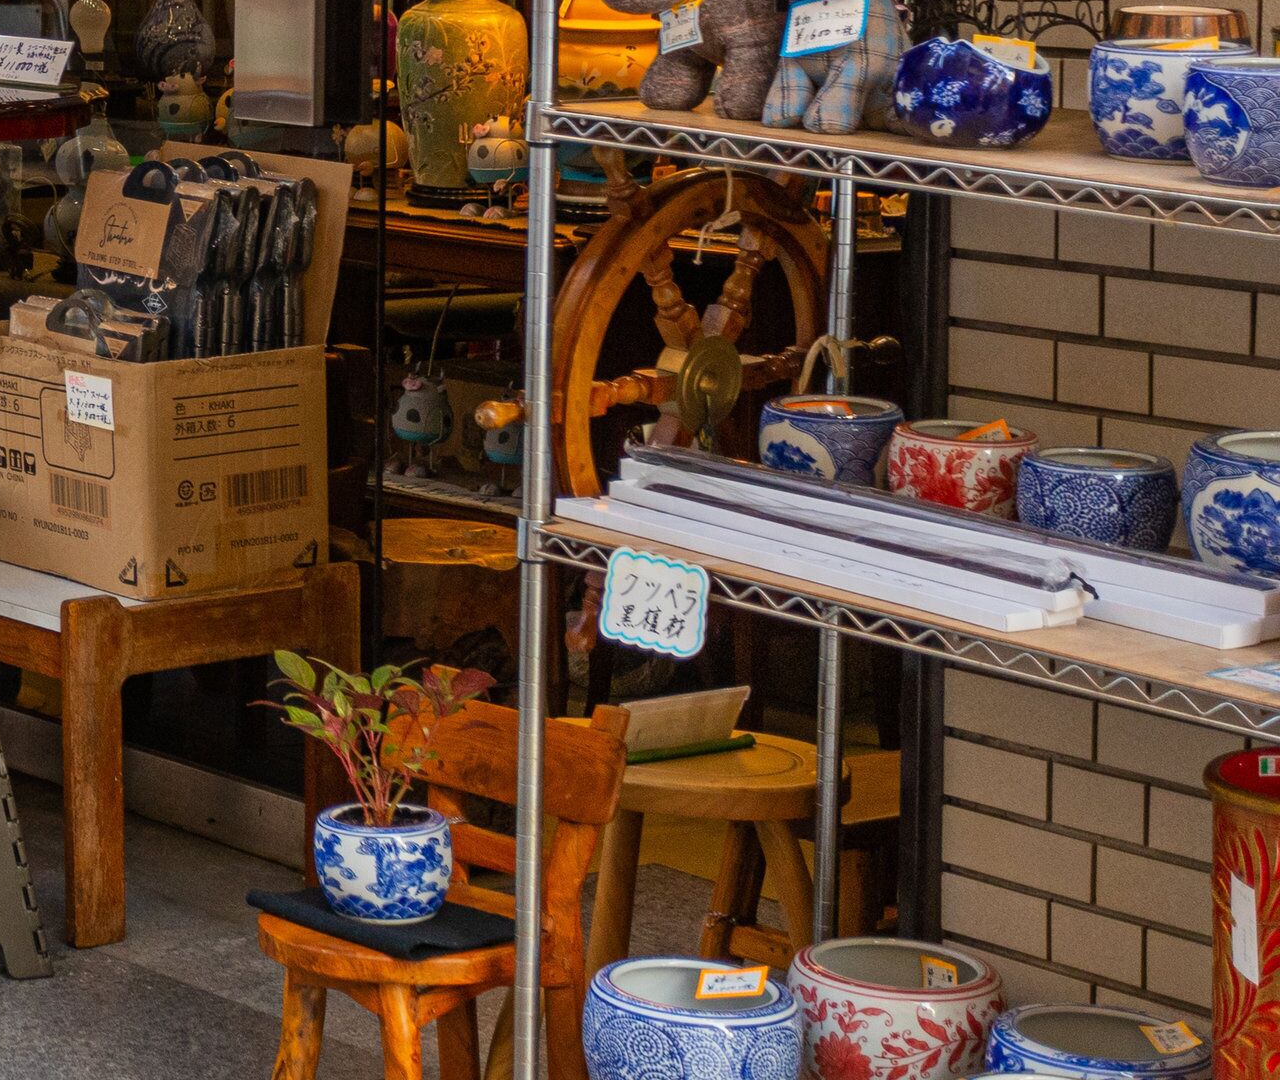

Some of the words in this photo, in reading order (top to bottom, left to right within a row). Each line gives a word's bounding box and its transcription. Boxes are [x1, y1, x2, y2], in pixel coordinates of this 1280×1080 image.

[88, 251, 108, 262] FOLDING
[108, 255, 121, 266] STEP
[122, 259, 138, 270] STOOL
[13, 398, 20, 412] 6
[175, 402, 186, 416] 色
[208, 399, 235, 412] KHAKI
[227, 416, 236, 428] 6
[7, 473, 25, 483] CHINA
[8, 511, 18, 521] NO
[33, 518, 89, 540] RYUN201811-0003
[178, 547, 192, 555] P/O
[193, 544, 204, 553] NO
[230, 532, 299, 549] RYUN201811-0003
